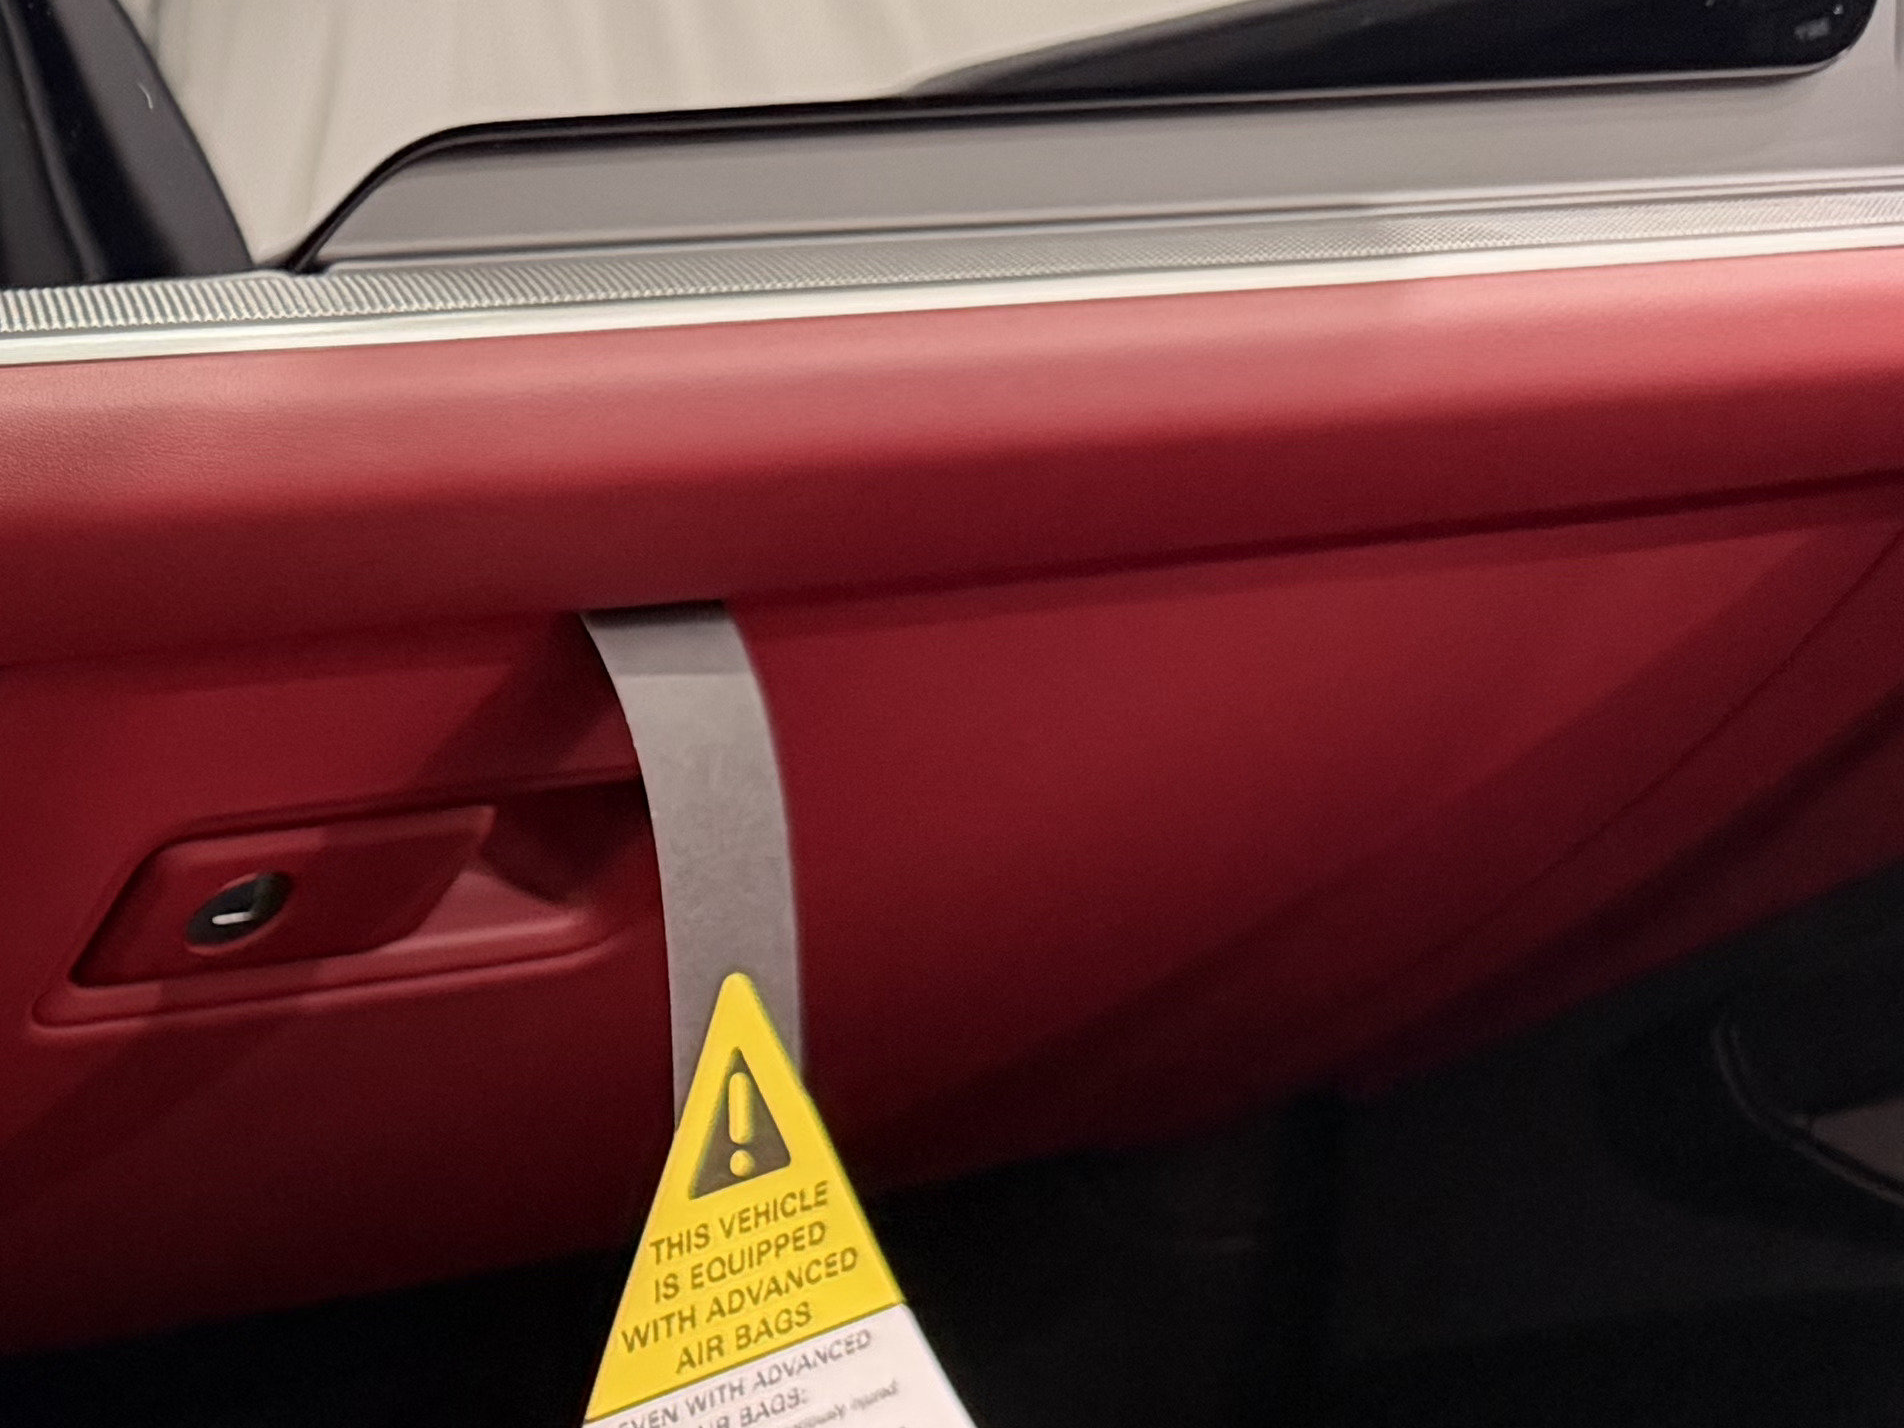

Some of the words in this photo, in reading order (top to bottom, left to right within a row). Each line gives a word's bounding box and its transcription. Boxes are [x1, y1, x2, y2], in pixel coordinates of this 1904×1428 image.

[650, 1223, 710, 1265] THIS
[719, 1181, 827, 1239] VEHICLE
[655, 1273, 680, 1303] IS
[691, 1221, 826, 1290] EQUIPPED
[622, 1305, 696, 1353] WITH
[706, 1247, 858, 1323] ADVANCED
[676, 1335, 724, 1374] AIR
[736, 1302, 812, 1350] BAGS
[686, 1379, 745, 1417] WITH
[753, 1332, 871, 1390] ADVANCED
